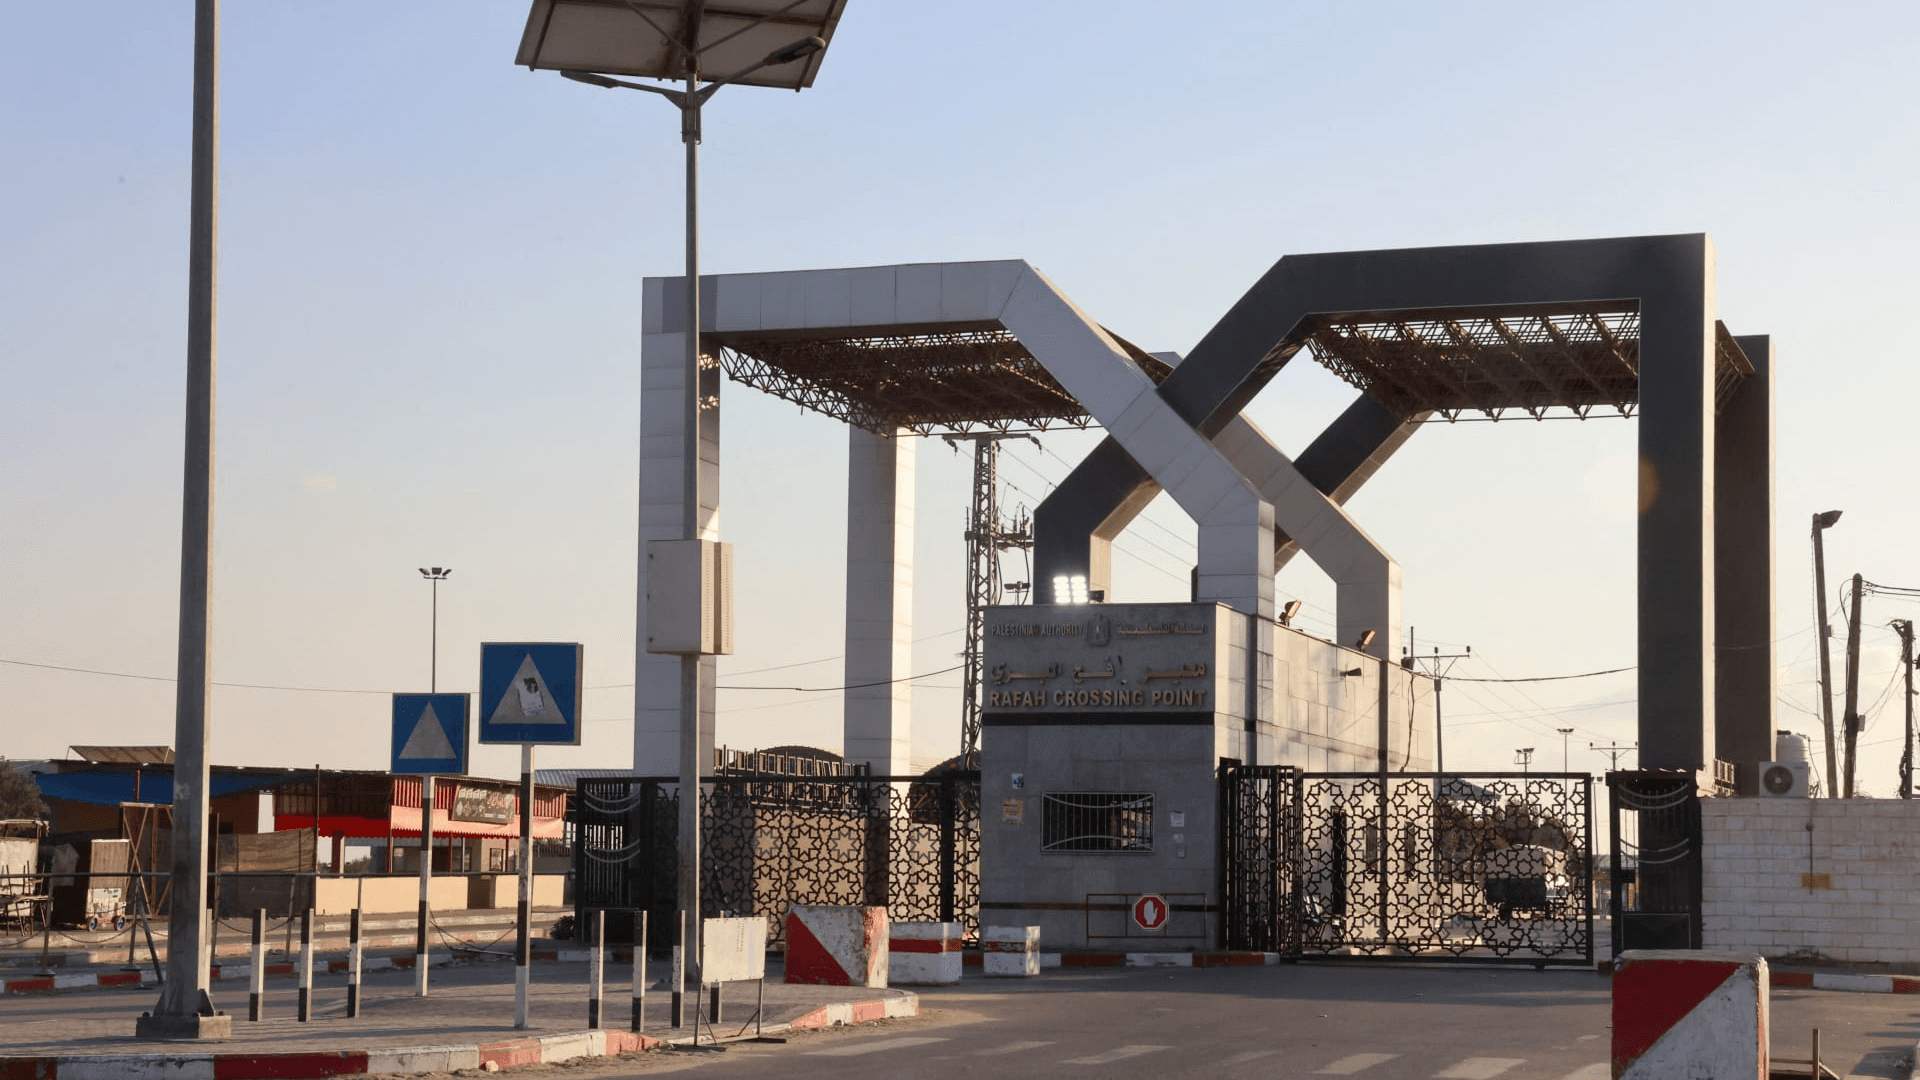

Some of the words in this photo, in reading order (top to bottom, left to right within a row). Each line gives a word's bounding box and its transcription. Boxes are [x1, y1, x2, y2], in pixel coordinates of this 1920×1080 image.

[1041, 622, 1084, 637] AUTHORITY
[1142, 663, 1206, 685] معبر
[990, 691, 1046, 707] RAFAH
[1054, 690, 1144, 707] CROSSING
[1152, 690, 1206, 706] POINT
